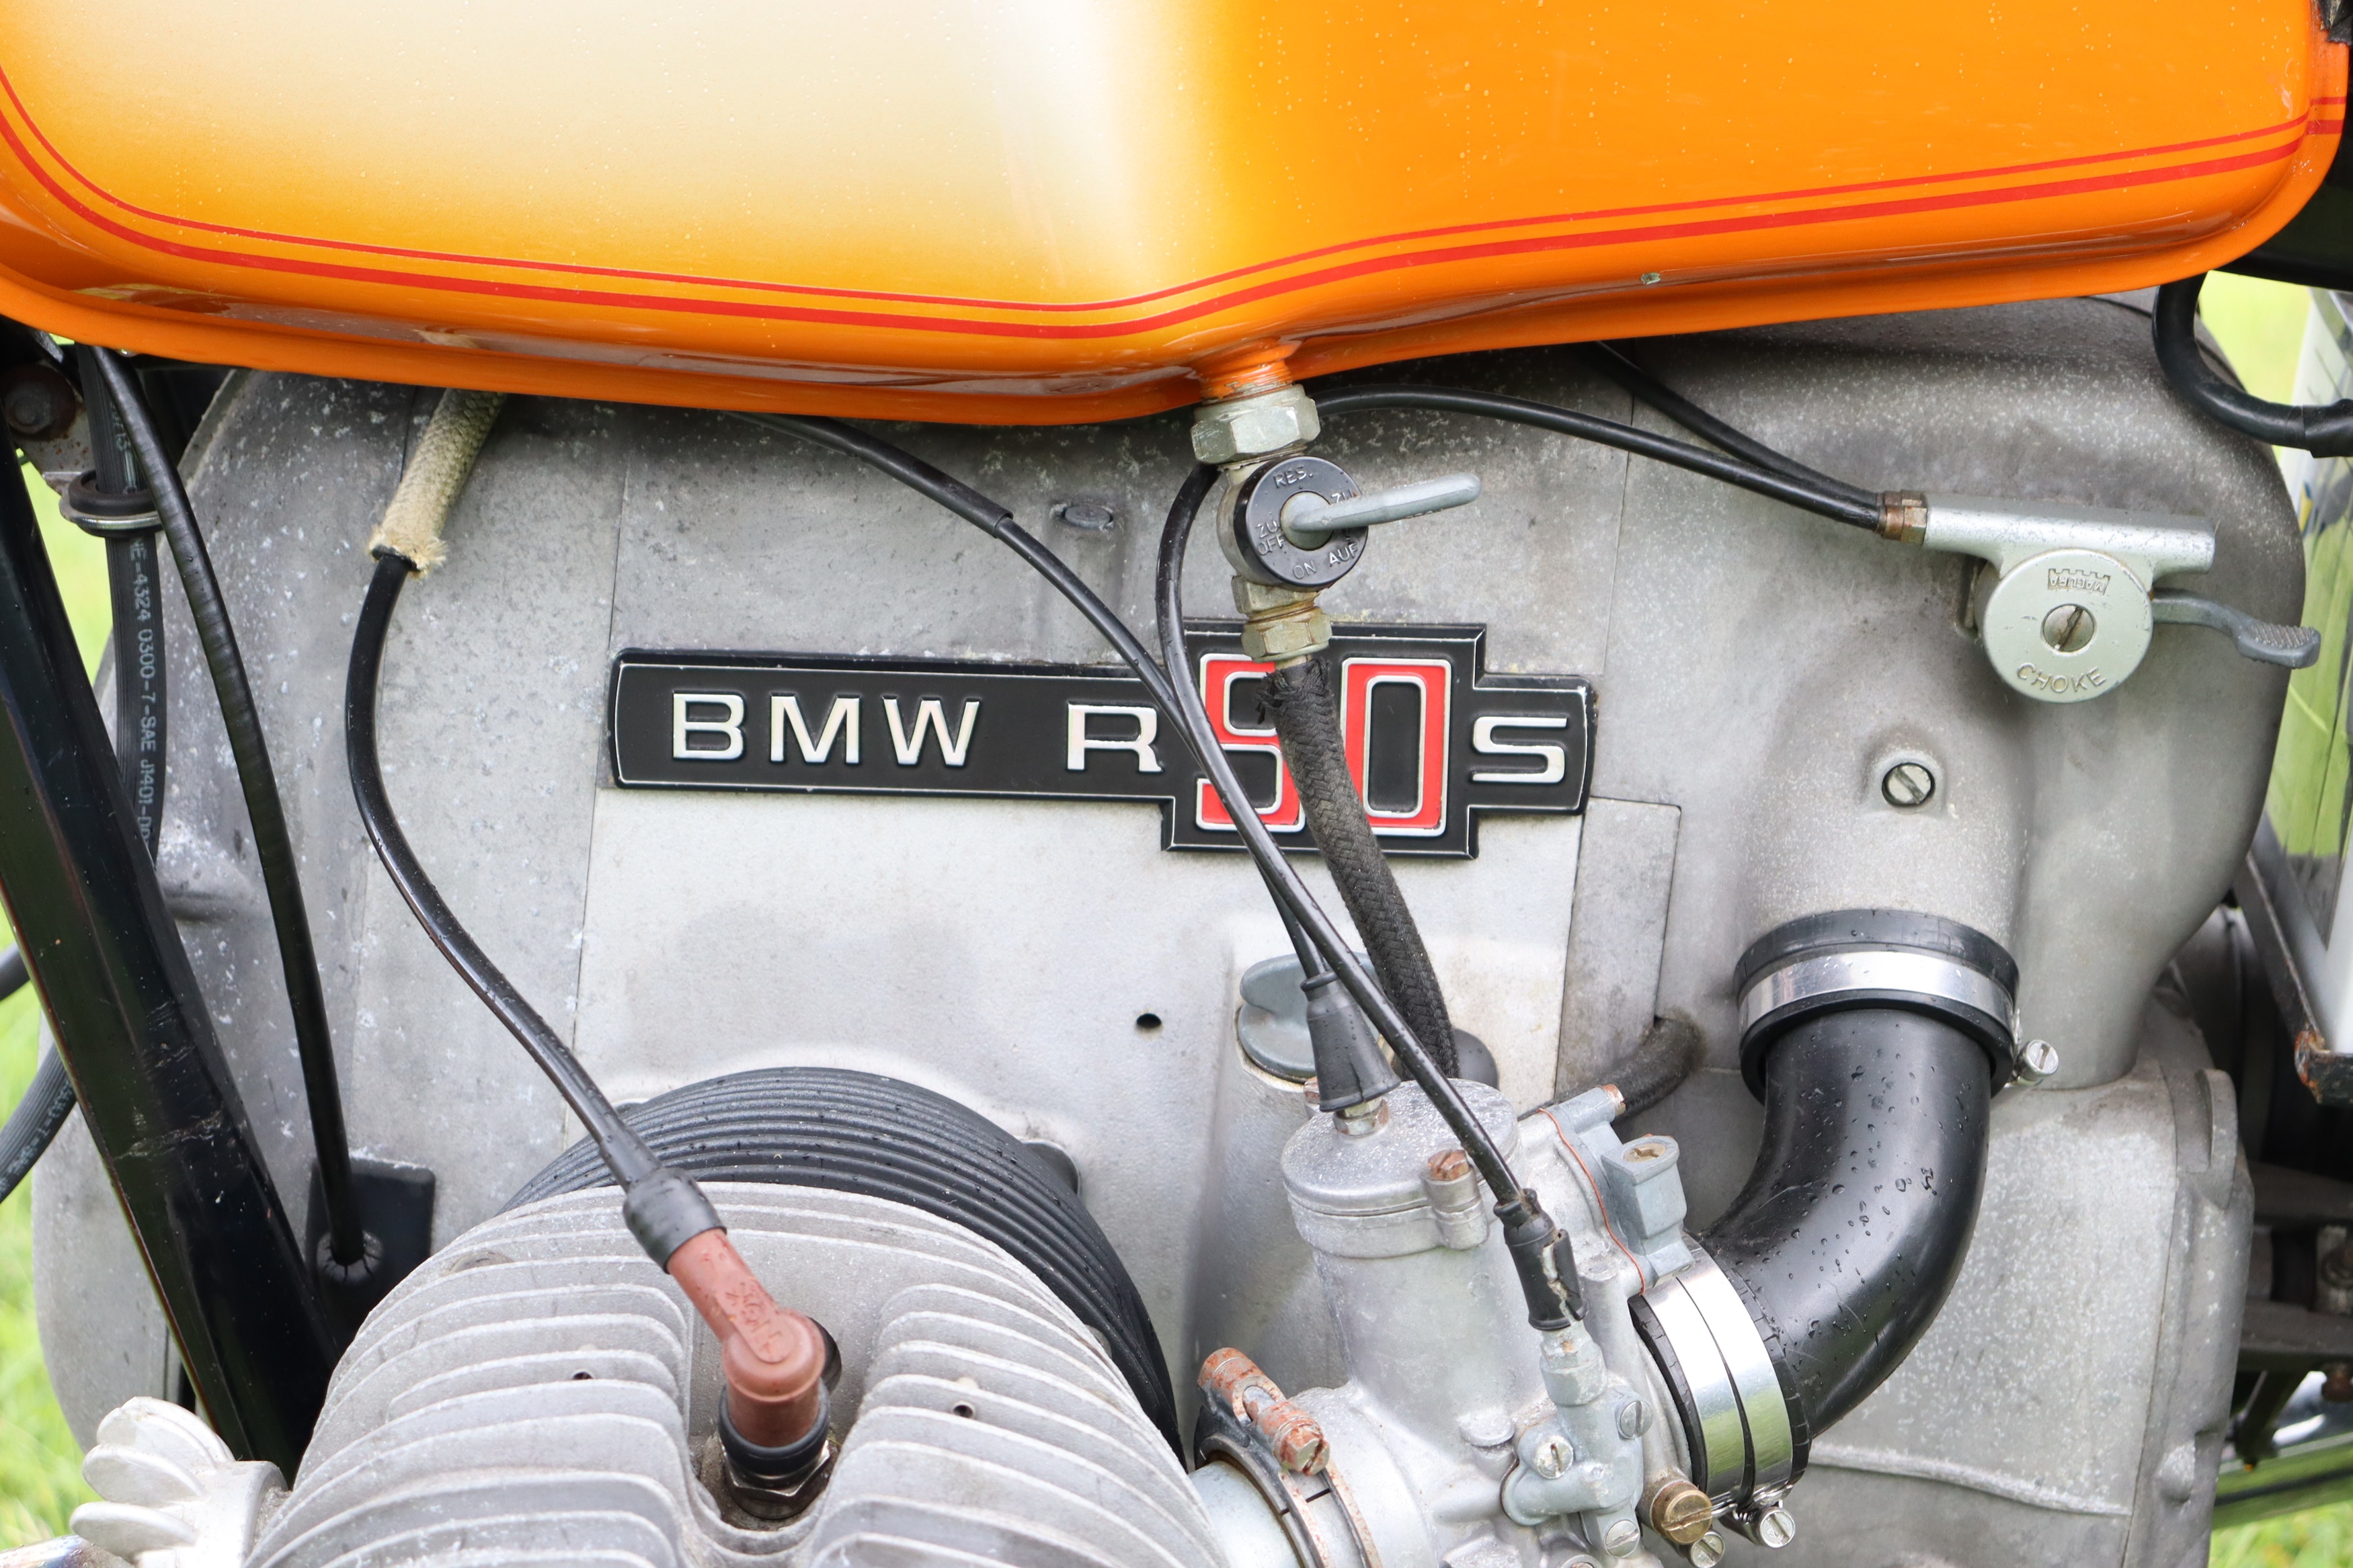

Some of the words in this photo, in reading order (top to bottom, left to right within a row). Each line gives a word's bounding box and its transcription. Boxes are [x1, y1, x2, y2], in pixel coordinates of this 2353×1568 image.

[1273, 466, 1313, 488] RES.
[1257, 535, 1285, 556] OFF
[1328, 542, 1359, 567] AUF
[1293, 560, 1317, 579] ON
[2050, 575, 2106, 594] MAGURA
[2017, 662, 2106, 693] CHOKE
[672, 692, 980, 766] BMW
